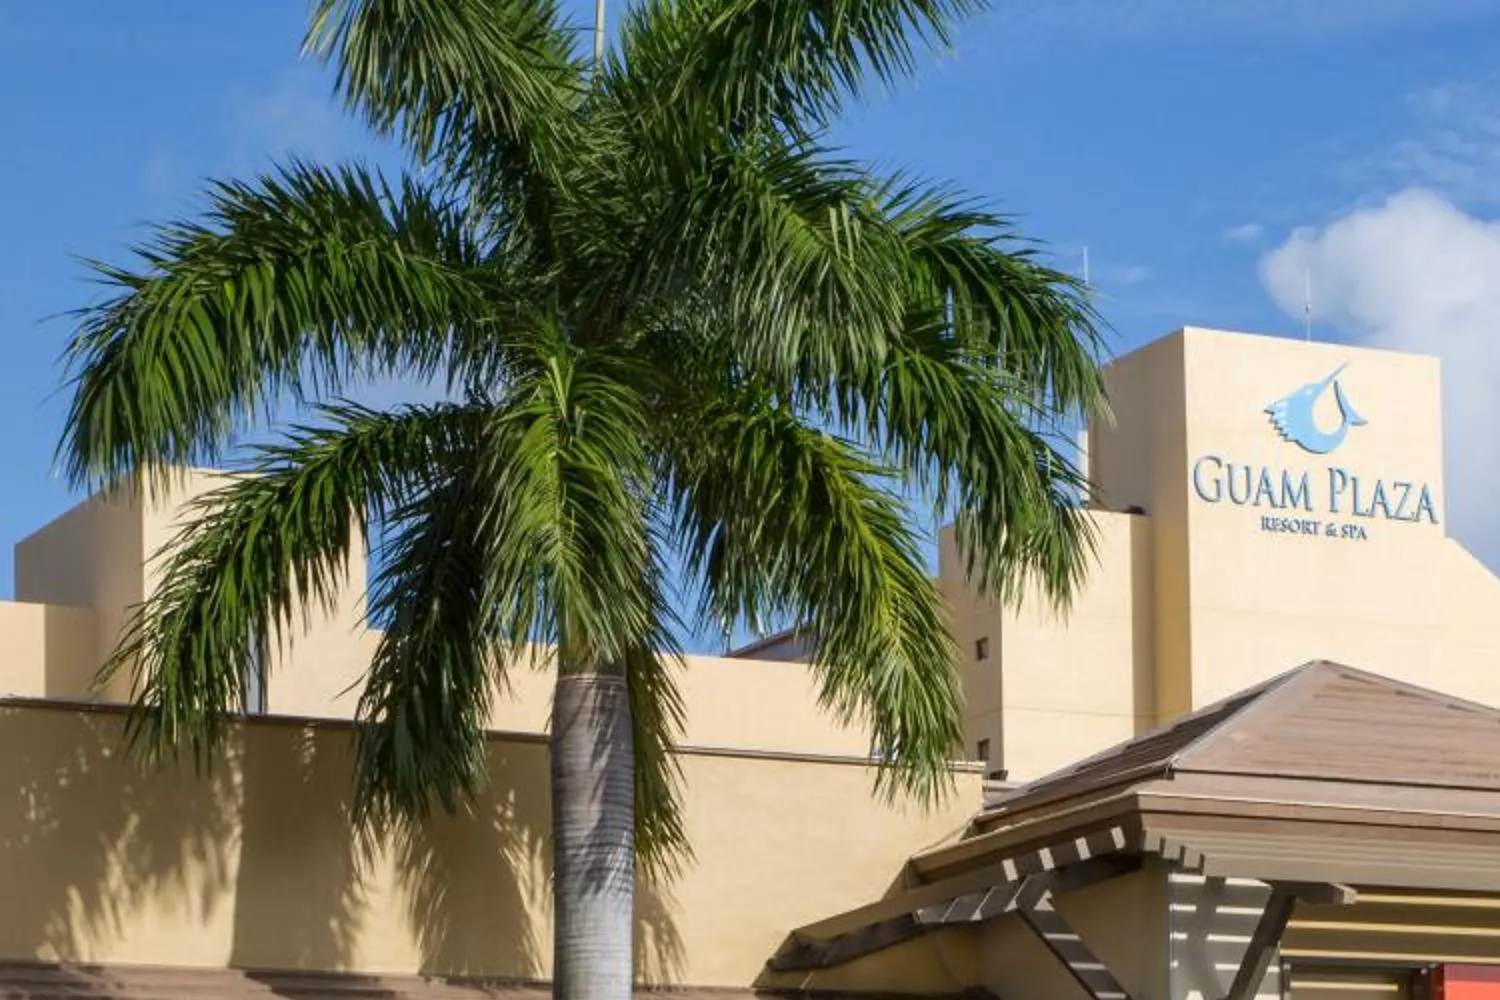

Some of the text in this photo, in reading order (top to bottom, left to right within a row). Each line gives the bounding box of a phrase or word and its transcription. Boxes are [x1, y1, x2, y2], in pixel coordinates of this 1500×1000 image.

[1193, 455, 1439, 524] GUAM PLAZA
[1260, 515, 1368, 541] RESORT & SPA
